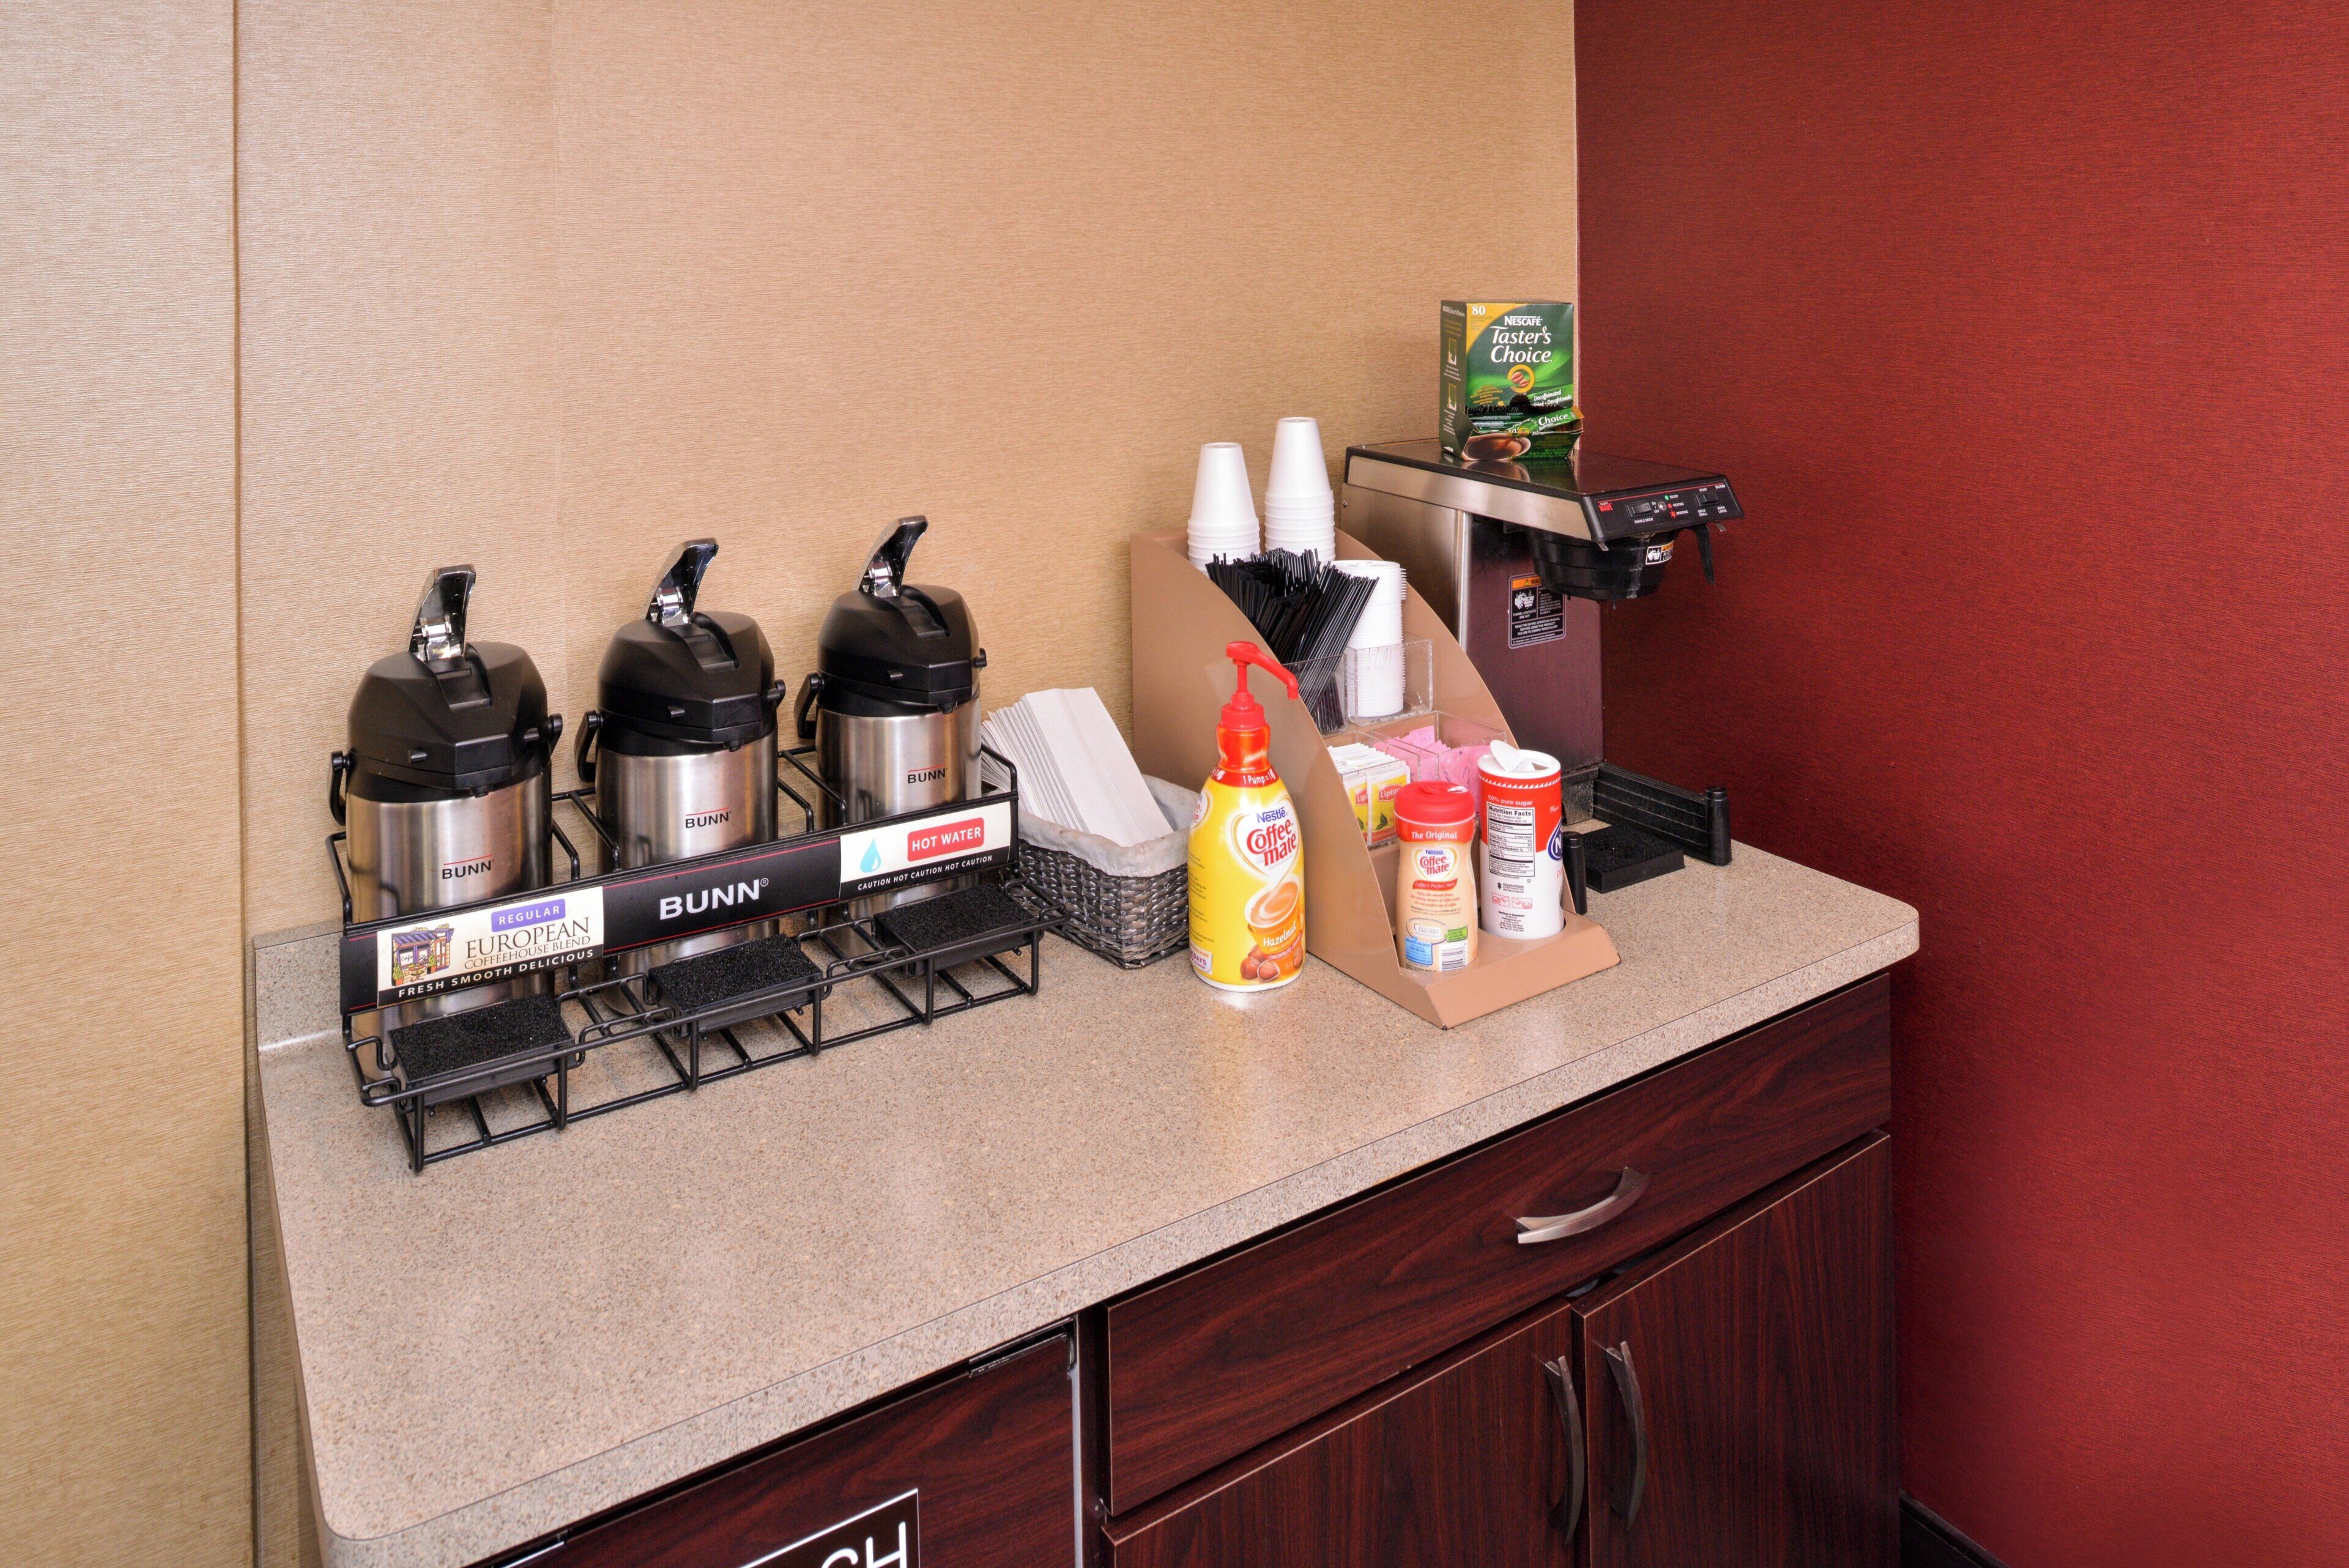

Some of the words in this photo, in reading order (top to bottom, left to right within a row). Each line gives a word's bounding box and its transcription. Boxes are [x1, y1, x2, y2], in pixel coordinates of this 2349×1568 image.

[1472, 305, 1486, 315] 80
[1490, 325, 1551, 344] Taster's
[1491, 345, 1551, 363] Choice
[1534, 389, 1562, 401] Decaffeinated
[1538, 414, 1568, 426] Choice
[908, 769, 946, 784] BUNN
[1242, 775, 1247, 784] 1
[1256, 806, 1286, 823] Nestlé
[1489, 805, 1512, 815] Nutrition
[685, 814, 730, 828] BUNN
[912, 836, 937, 852] HOT
[941, 827, 981, 845] WATER
[1426, 831, 1458, 840] Original
[1263, 833, 1297, 866] mate
[442, 861, 492, 880] BUNN
[858, 877, 890, 891] CAUTION
[894, 874, 908, 884] HOT
[911, 868, 943, 880] CAUTION
[946, 863, 960, 873] HOT
[962, 855, 992, 868] CAUTION
[1427, 863, 1449, 875] mate
[659, 879, 759, 920] BUNN
[499, 905, 561, 926] REGULAR
[465, 916, 590, 959] EUROPEAN
[1263, 920, 1296, 947] Hazelnut
[464, 943, 549, 970] COFFEEHOUSE
[552, 935, 591, 950] BLEND
[398, 980, 445, 998] FRESH
[451, 965, 513, 986] SMOOTH
[519, 949, 594, 972] DELICIOUS
